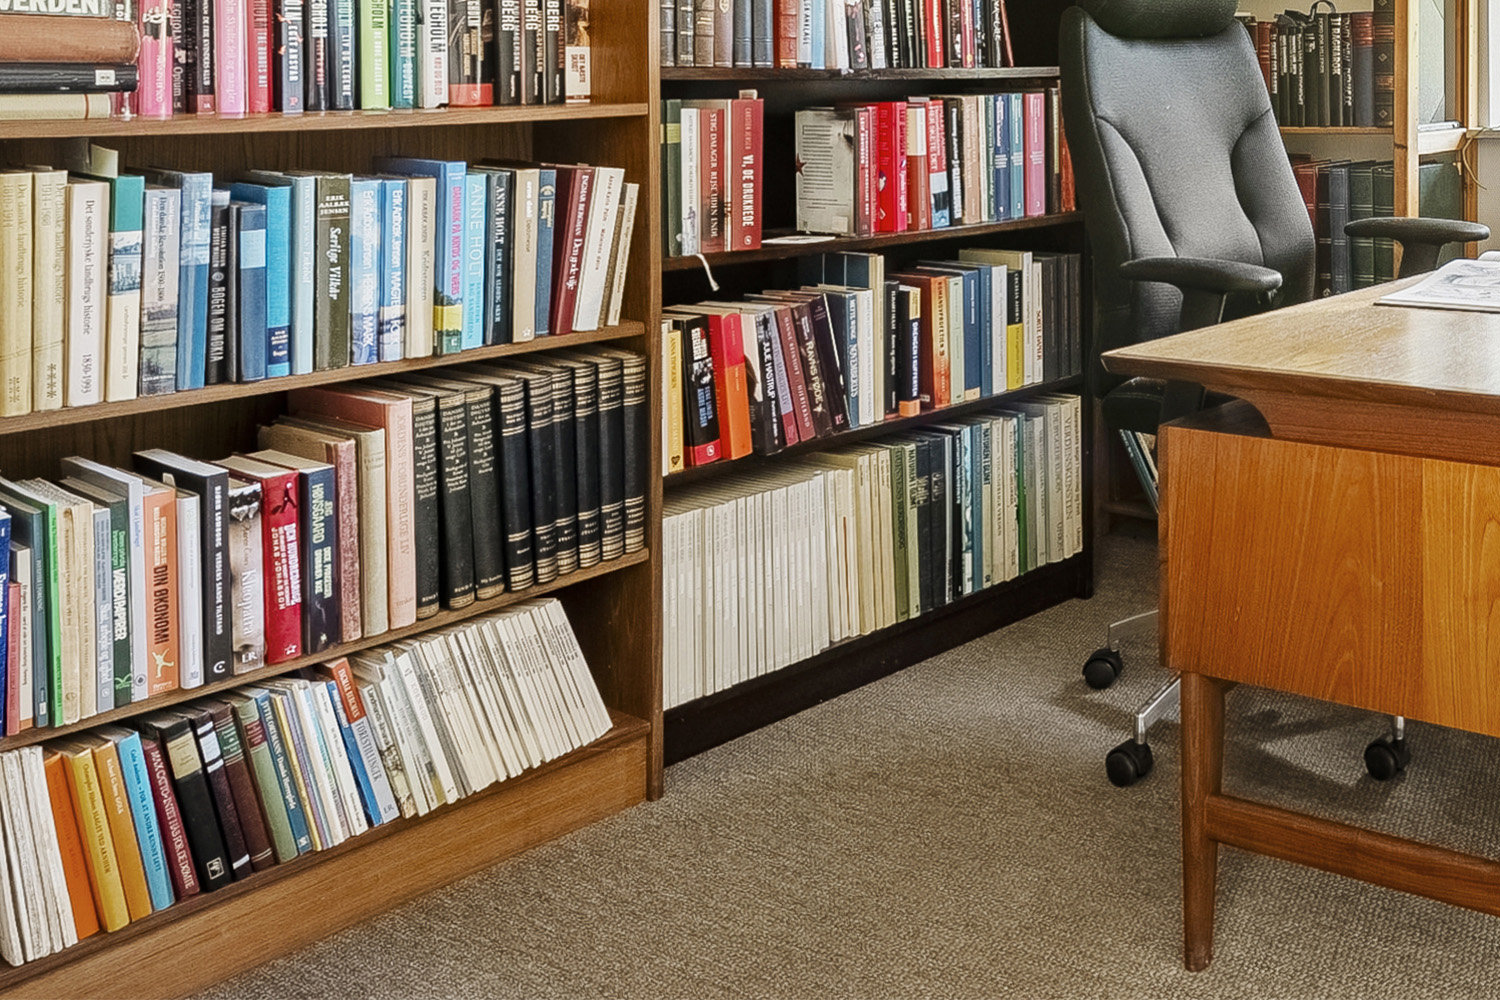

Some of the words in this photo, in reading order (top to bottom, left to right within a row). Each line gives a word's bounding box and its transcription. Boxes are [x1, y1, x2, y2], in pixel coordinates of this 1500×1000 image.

[430, 7, 445, 53] EGHOLM
[173, 67, 182, 96] Opium
[85, 200, 95, 213] Det
[470, 183, 483, 229] ANNE
[495, 186, 505, 212] ANNE
[470, 235, 481, 277] HOLT
[211, 287, 225, 315] BOGEN
[210, 334, 223, 361] NOKIA
